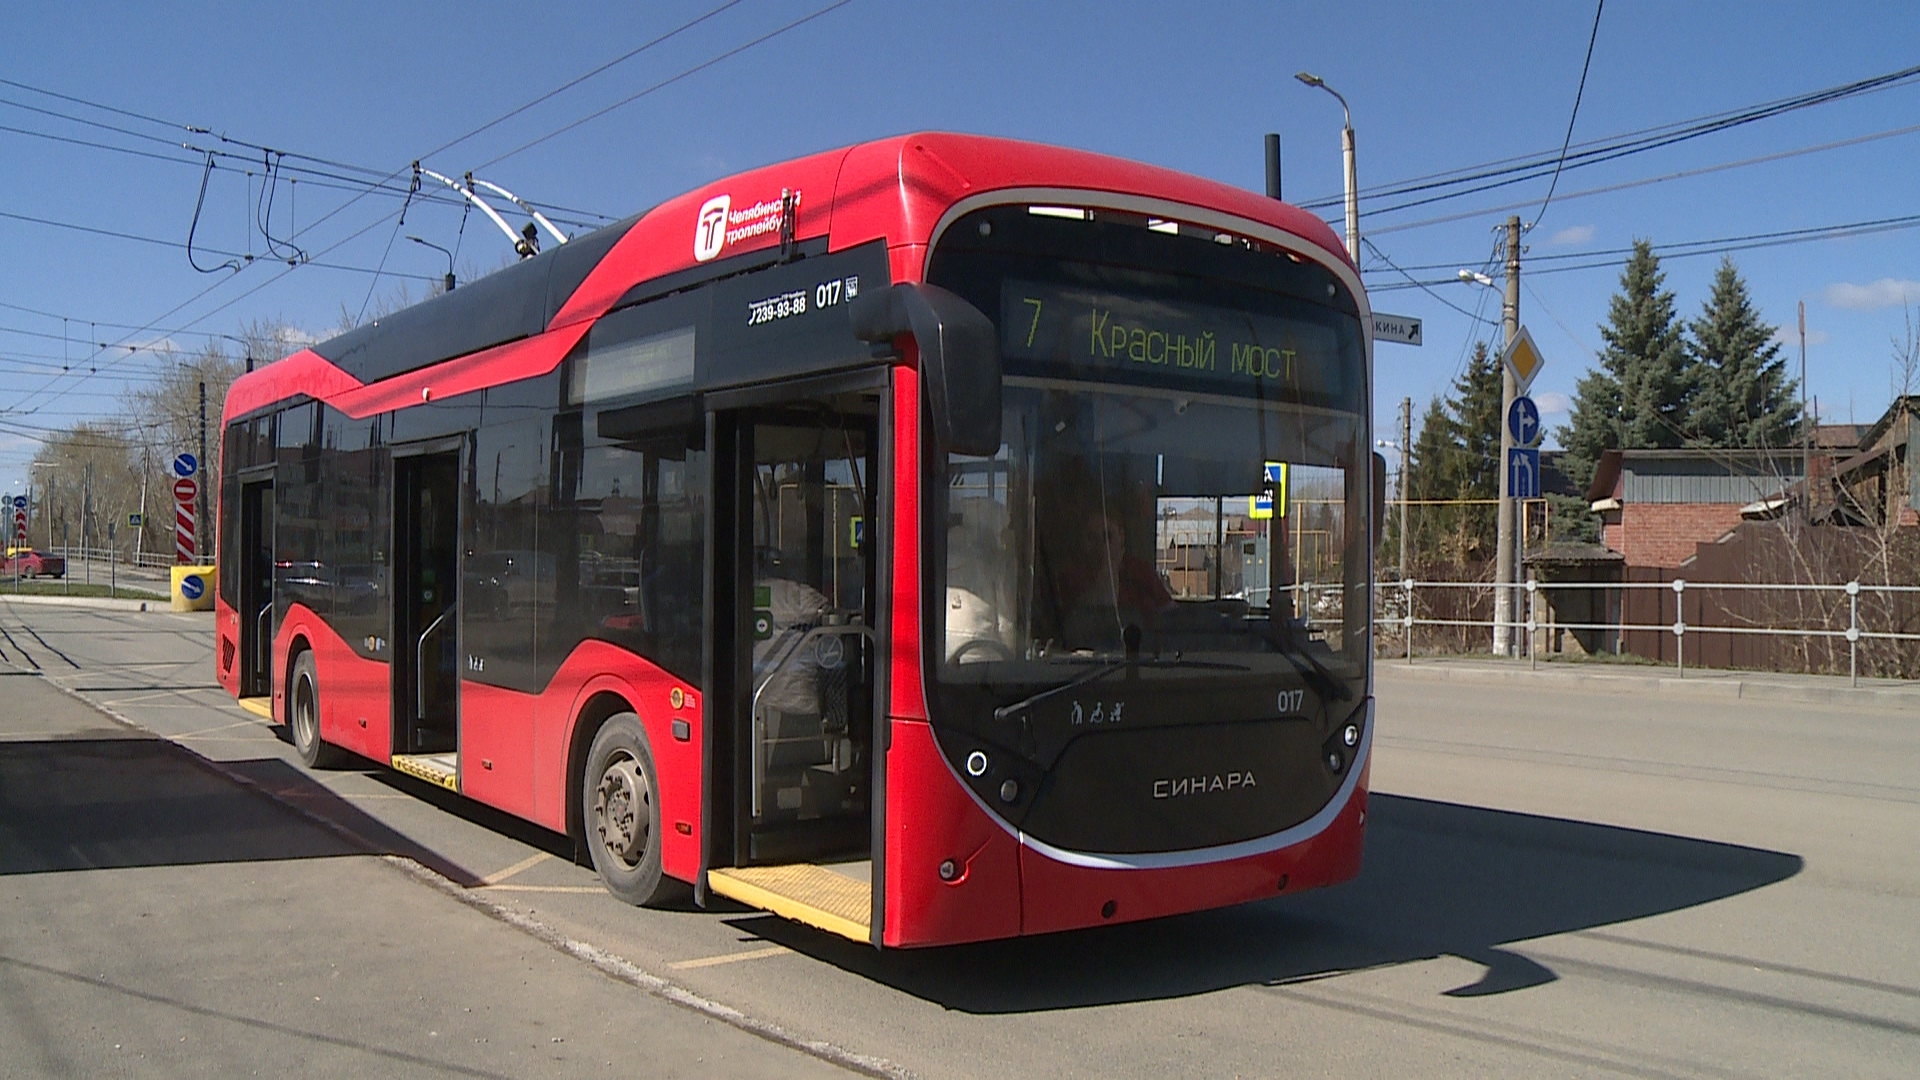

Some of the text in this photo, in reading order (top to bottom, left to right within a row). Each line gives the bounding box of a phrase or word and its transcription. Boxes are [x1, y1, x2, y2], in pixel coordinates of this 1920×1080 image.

[728, 189, 802, 225] Челябинсй
[725, 214, 784, 245] троллейбу
[815, 280, 842, 309] 017
[755, 296, 806, 324] 239-93-88
[1023, 298, 1297, 381] 7 Красный мост
[1375, 320, 1405, 336] КИНА
[1277, 689, 1304, 713] 017
[1153, 771, 1256, 799] СИНАРА
